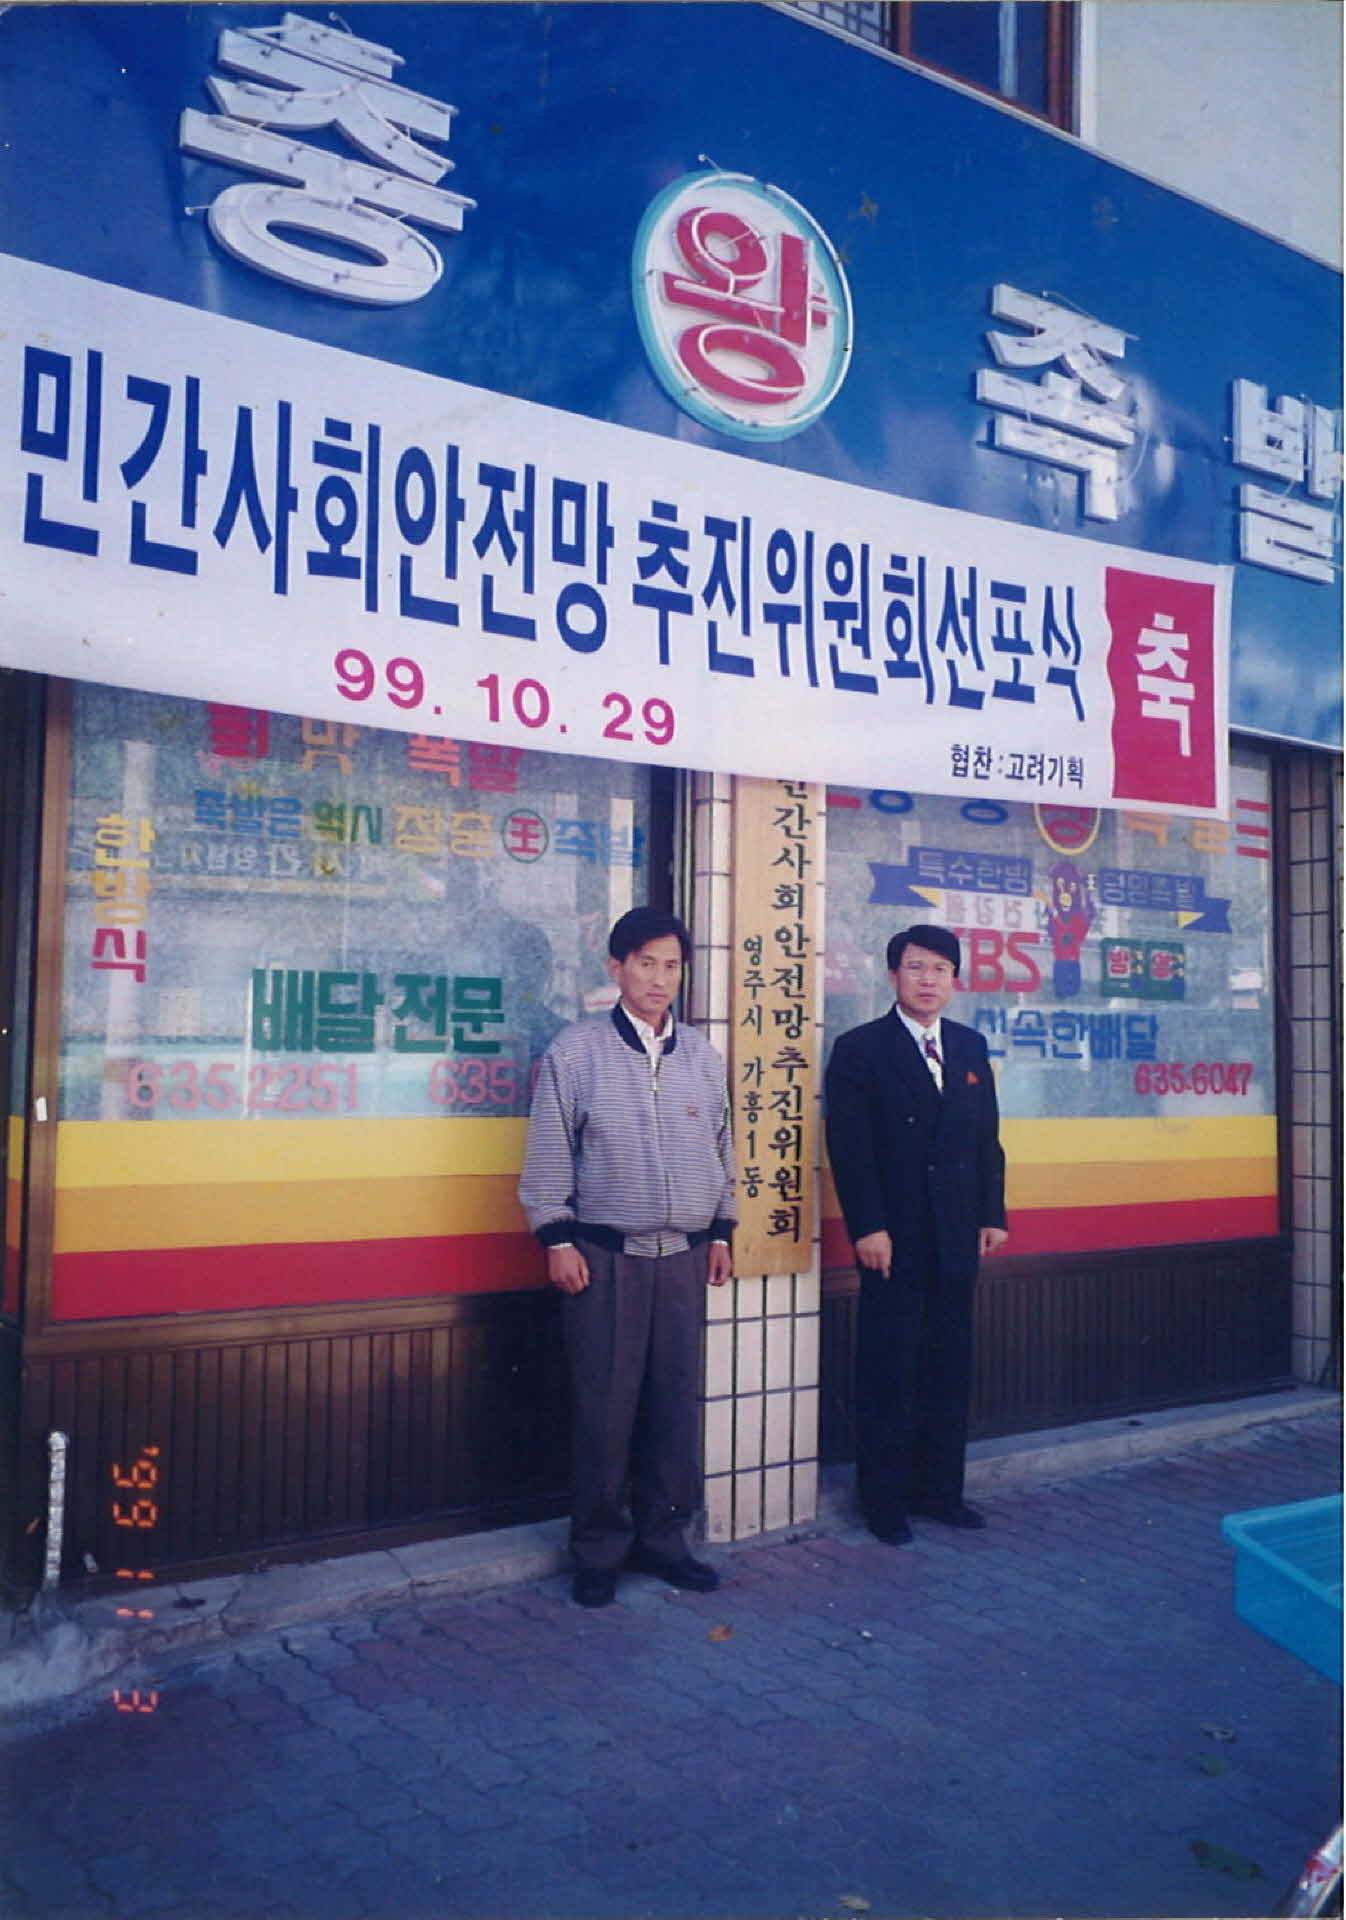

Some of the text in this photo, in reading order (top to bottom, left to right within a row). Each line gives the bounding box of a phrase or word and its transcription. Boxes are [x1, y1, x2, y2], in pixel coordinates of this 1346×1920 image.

[661, 206, 832, 405] 왕
[975, 282, 1134, 521] 족
[1232, 378, 1345, 585] 발
[20, 345, 1085, 722] 민간사회안전망 추진위원회선포식
[334, 649, 675, 746] 99. 10. 29
[1135, 612, 1196, 757] 축
[252, 969, 504, 1053] 배달전문
[741, 935, 766, 1036] 영주시
